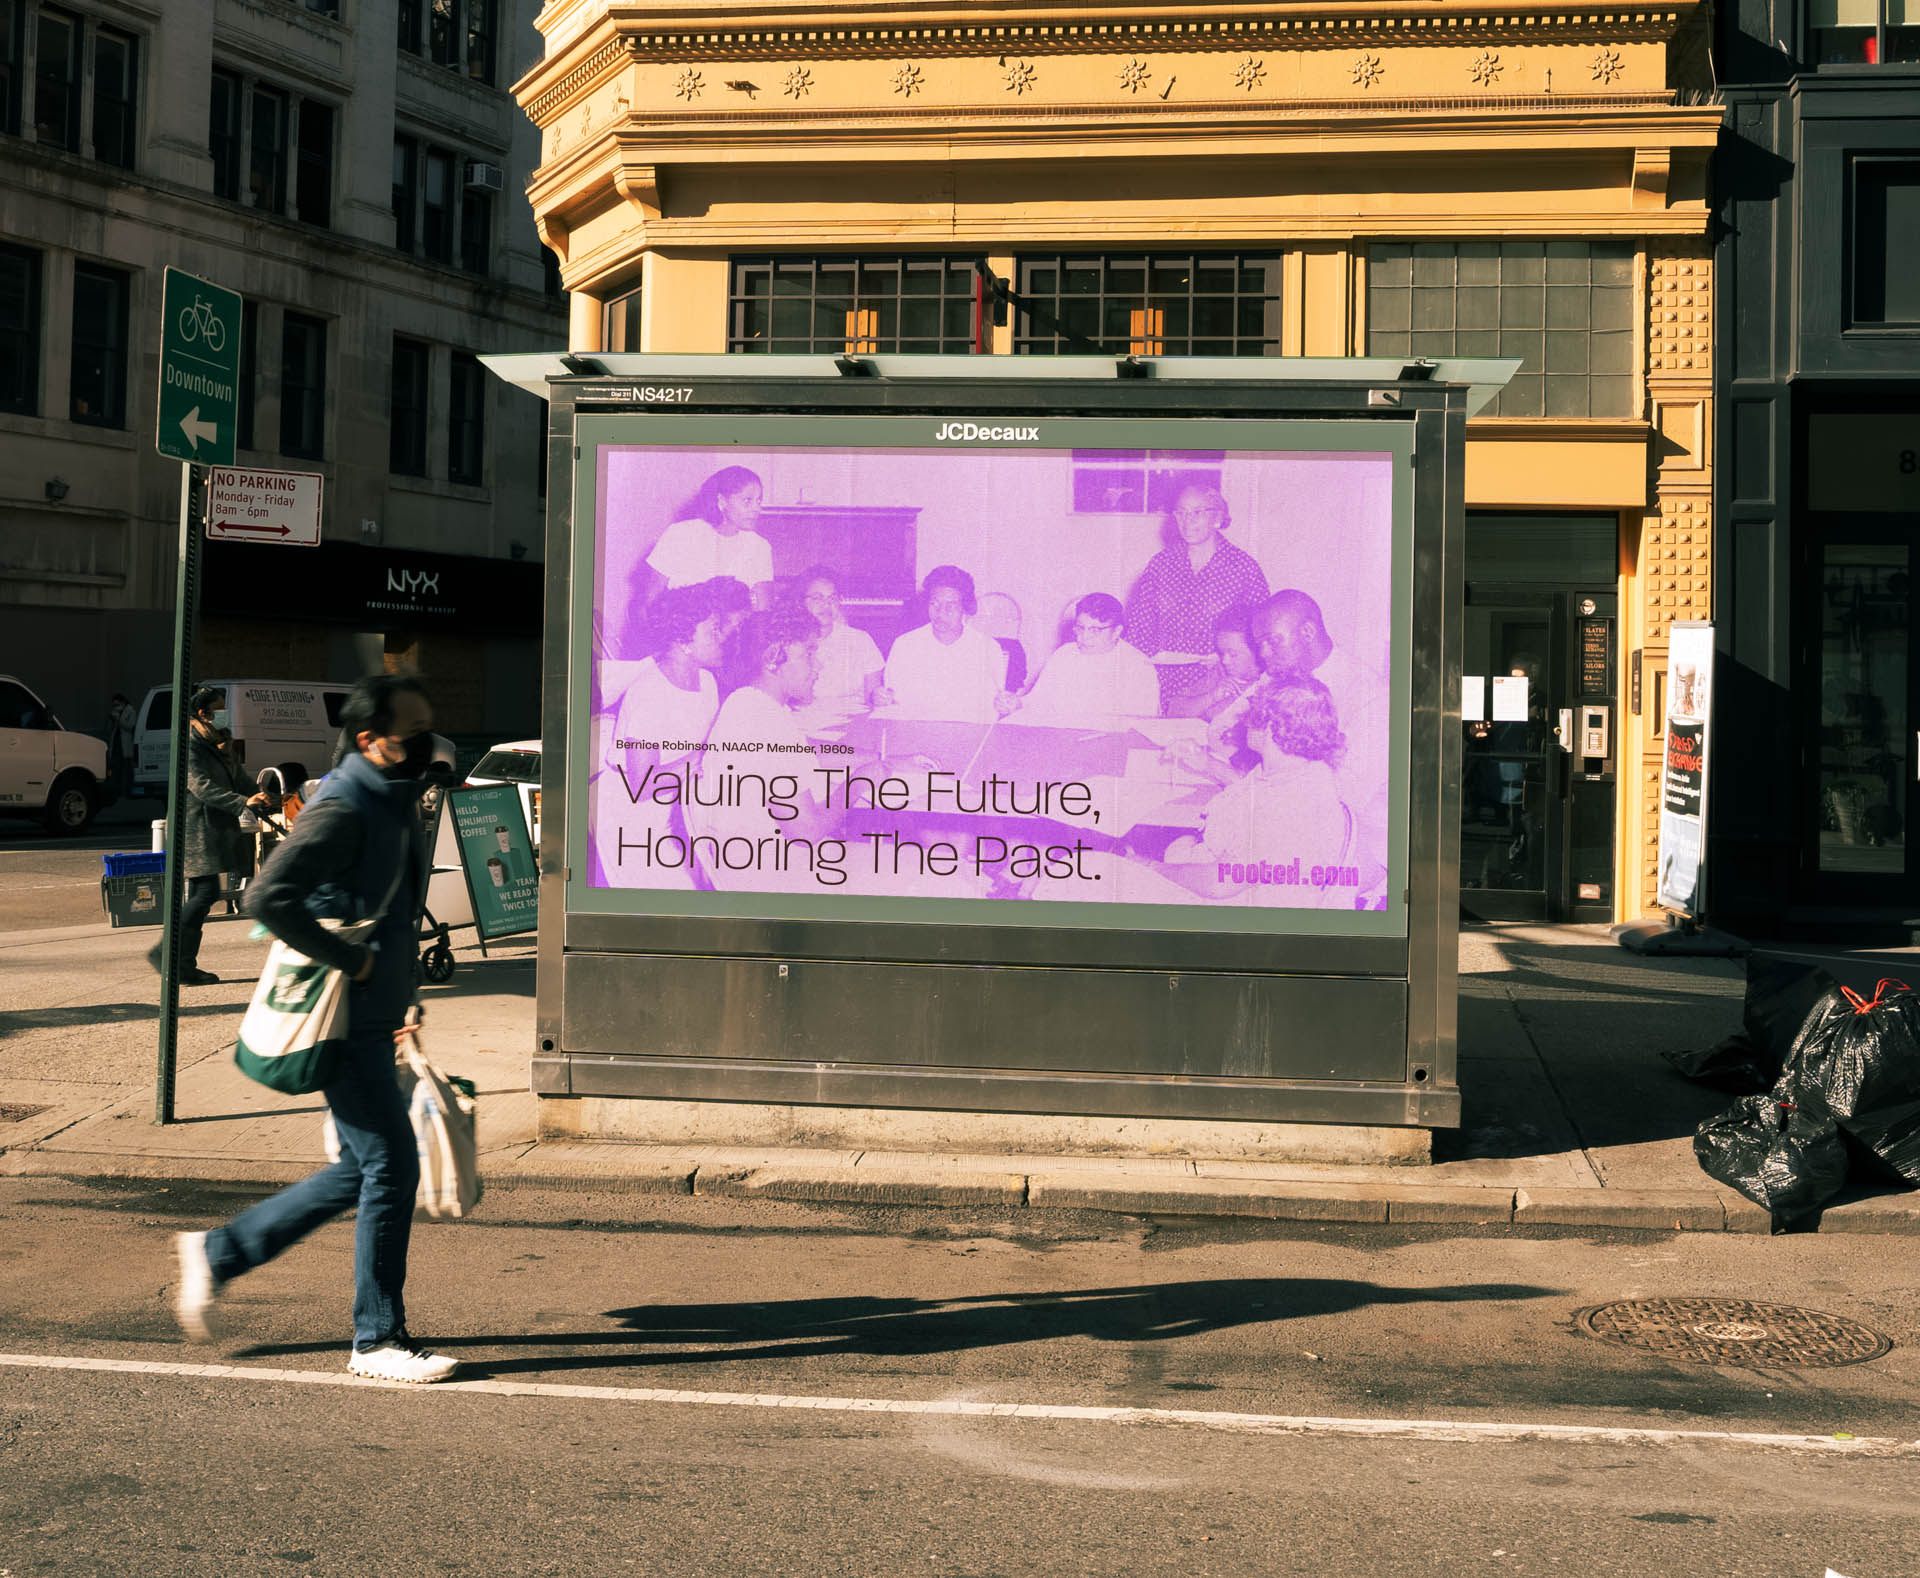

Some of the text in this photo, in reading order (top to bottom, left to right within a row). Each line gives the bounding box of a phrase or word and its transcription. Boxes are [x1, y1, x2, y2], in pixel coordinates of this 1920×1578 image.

[166, 362, 232, 402] Downtown
[632, 387, 693, 402] NS4217
[935, 423, 1040, 441] JCDecaux
[1899, 450, 1920, 474] 8
[217, 473, 296, 491] NO PARKING
[216, 490, 254, 505] Monday
[264, 494, 295, 508] Friday
[216, 503, 237, 515] 8am
[247, 506, 269, 518] 6pm
[387, 568, 439, 595] NYX
[249, 689, 311, 703] EDGE FLOORING
[616, 740, 855, 755] Bernice Robinson, NAACP Member, 1960s
[617, 762, 1101, 824] Valuing The Future,
[455, 806, 478, 815] HELLO
[458, 815, 498, 826] UNLIMITED
[461, 827, 487, 838] COFFEE
[618, 827, 1101, 885] Honoring The Past.
[1218, 857, 1359, 887] rooted.com
[499, 891, 511, 900] WE
[512, 889, 532, 898] READ
[503, 901, 525, 911] TWICE
